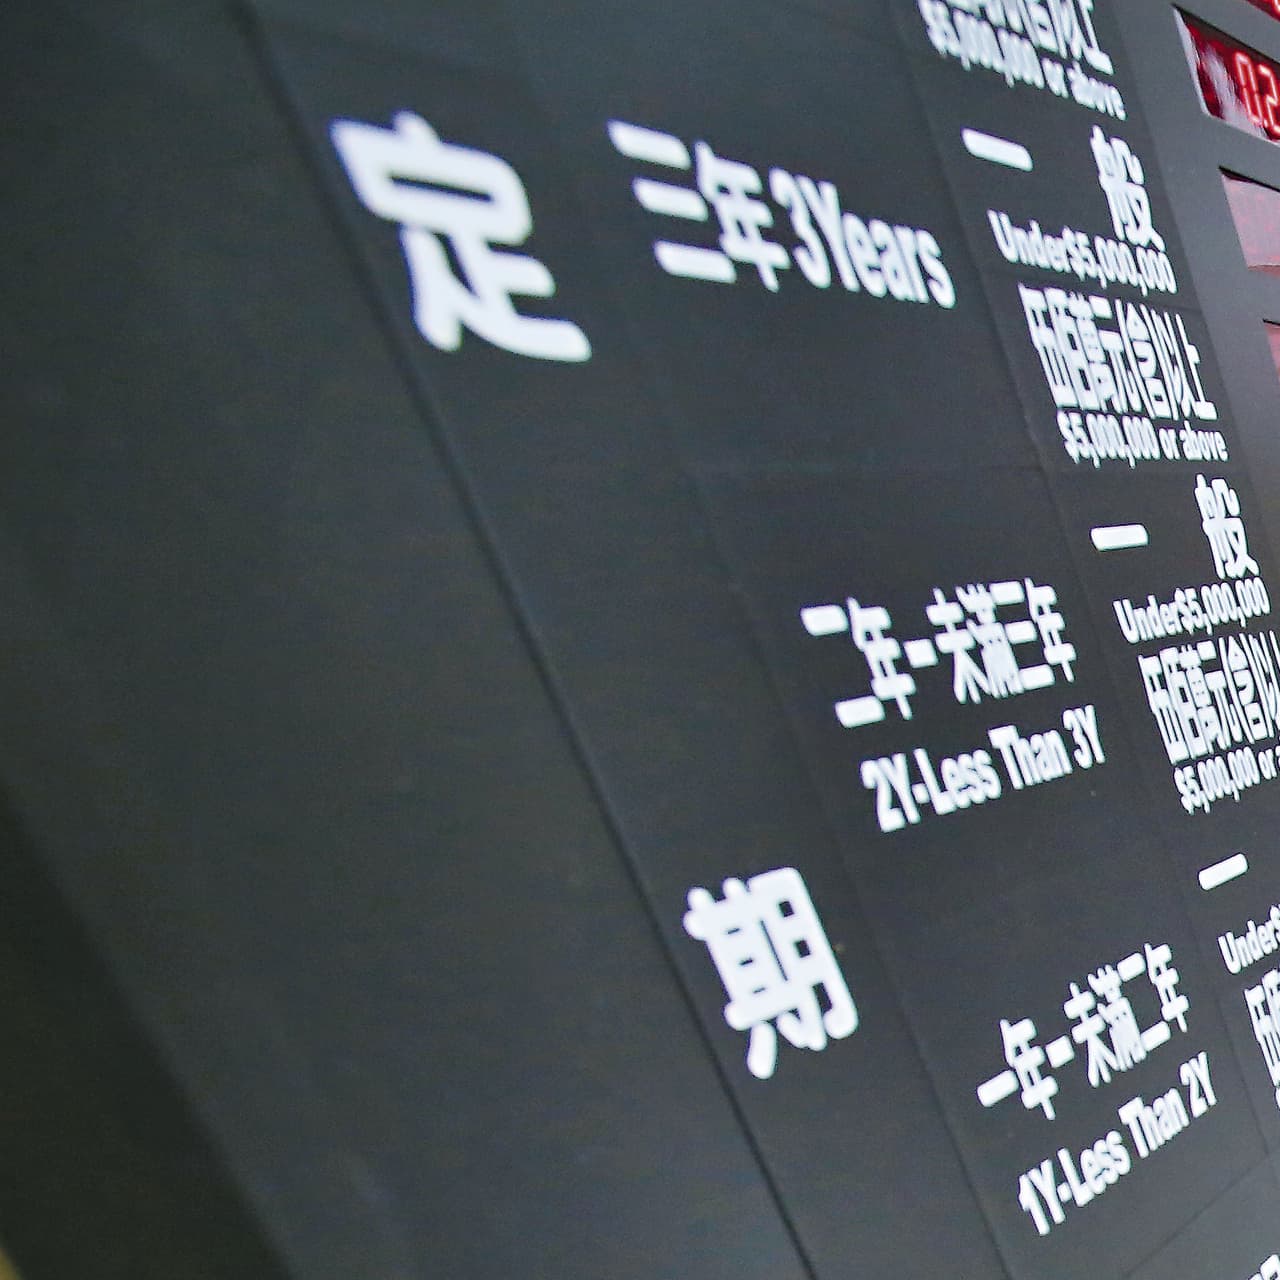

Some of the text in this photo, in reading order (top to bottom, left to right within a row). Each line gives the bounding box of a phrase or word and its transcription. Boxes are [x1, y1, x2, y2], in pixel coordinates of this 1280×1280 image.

[1183, 420, 1229, 461] above
[988, 720, 1072, 790] Than
[1063, 704, 1105, 766] 3Y
[684, 867, 859, 1078] 期
[1119, 1084, 1190, 1159] Than
[1178, 1052, 1218, 1117] 2Y
